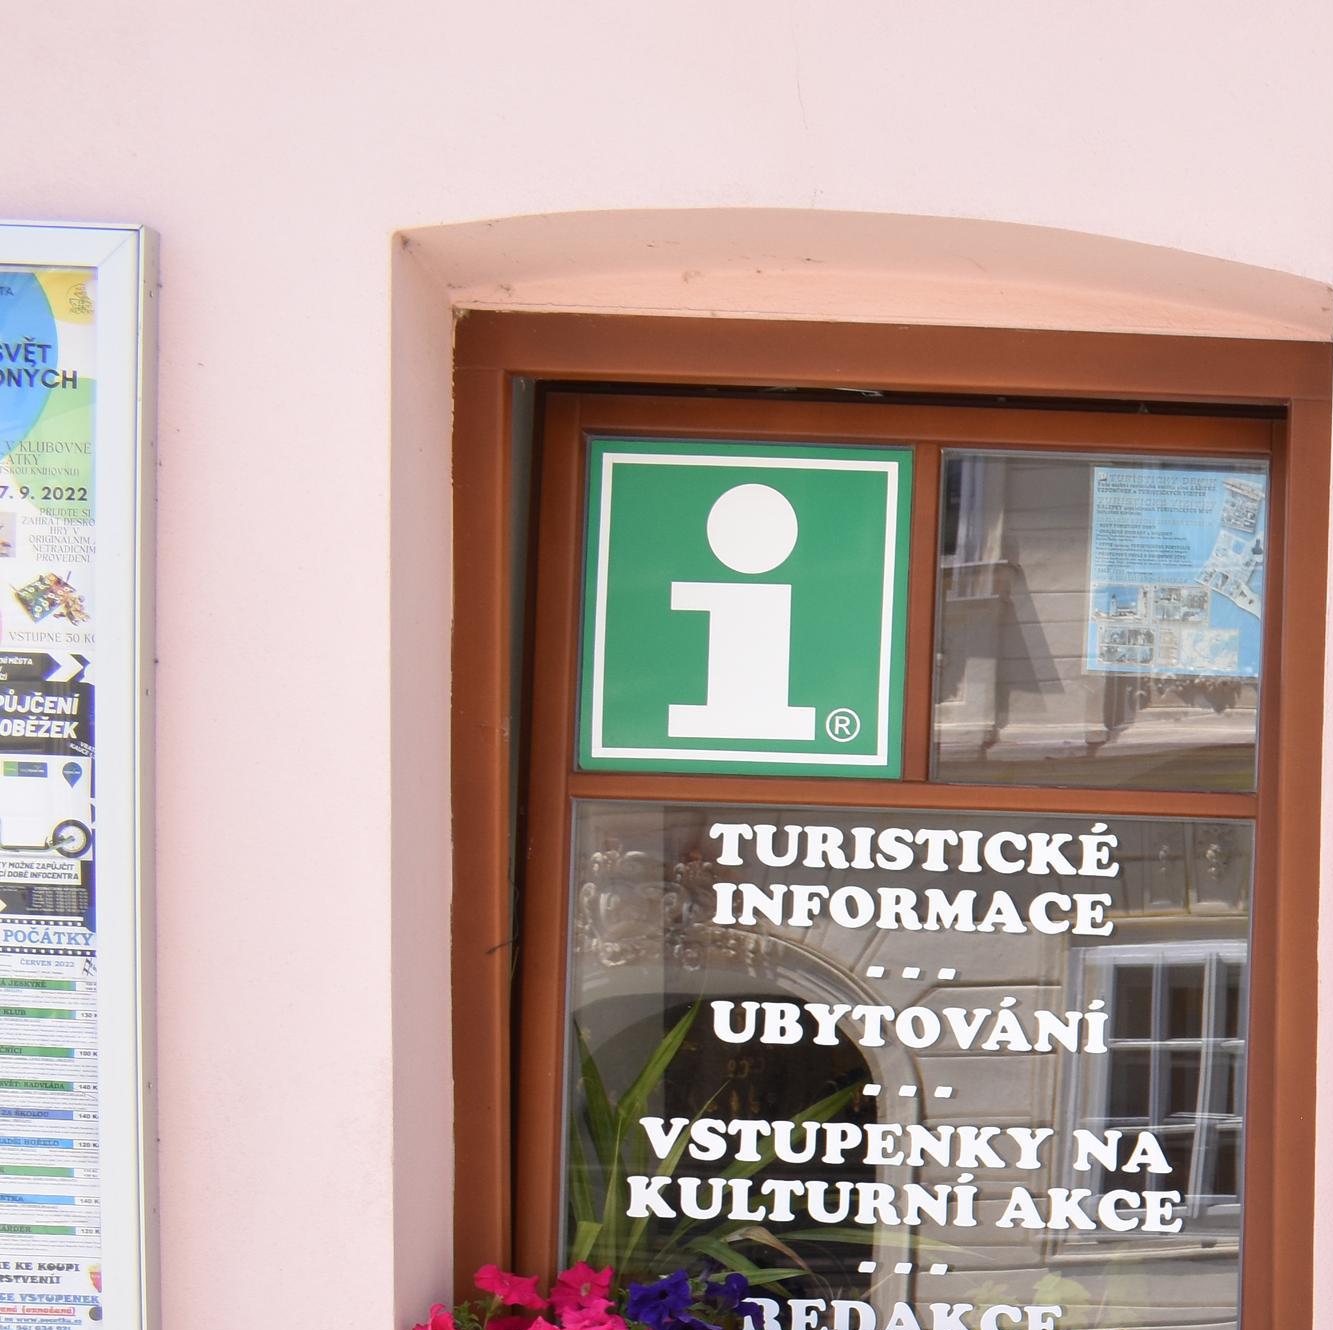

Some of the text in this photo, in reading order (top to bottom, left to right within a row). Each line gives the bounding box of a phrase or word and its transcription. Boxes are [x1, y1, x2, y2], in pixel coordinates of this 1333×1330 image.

[41, 486, 88, 501] 2022
[709, 822, 1121, 878] TURISTICKÉ
[3, 927, 94, 946] POČÁTKY
[710, 882, 1115, 937] INFORMACE
[709, 997, 1109, 1055] UBYTOVÁNÍ
[639, 1116, 1173, 1175] VSTUPENKY NA
[625, 1172, 1184, 1233] KULTURNÍ AKCE
